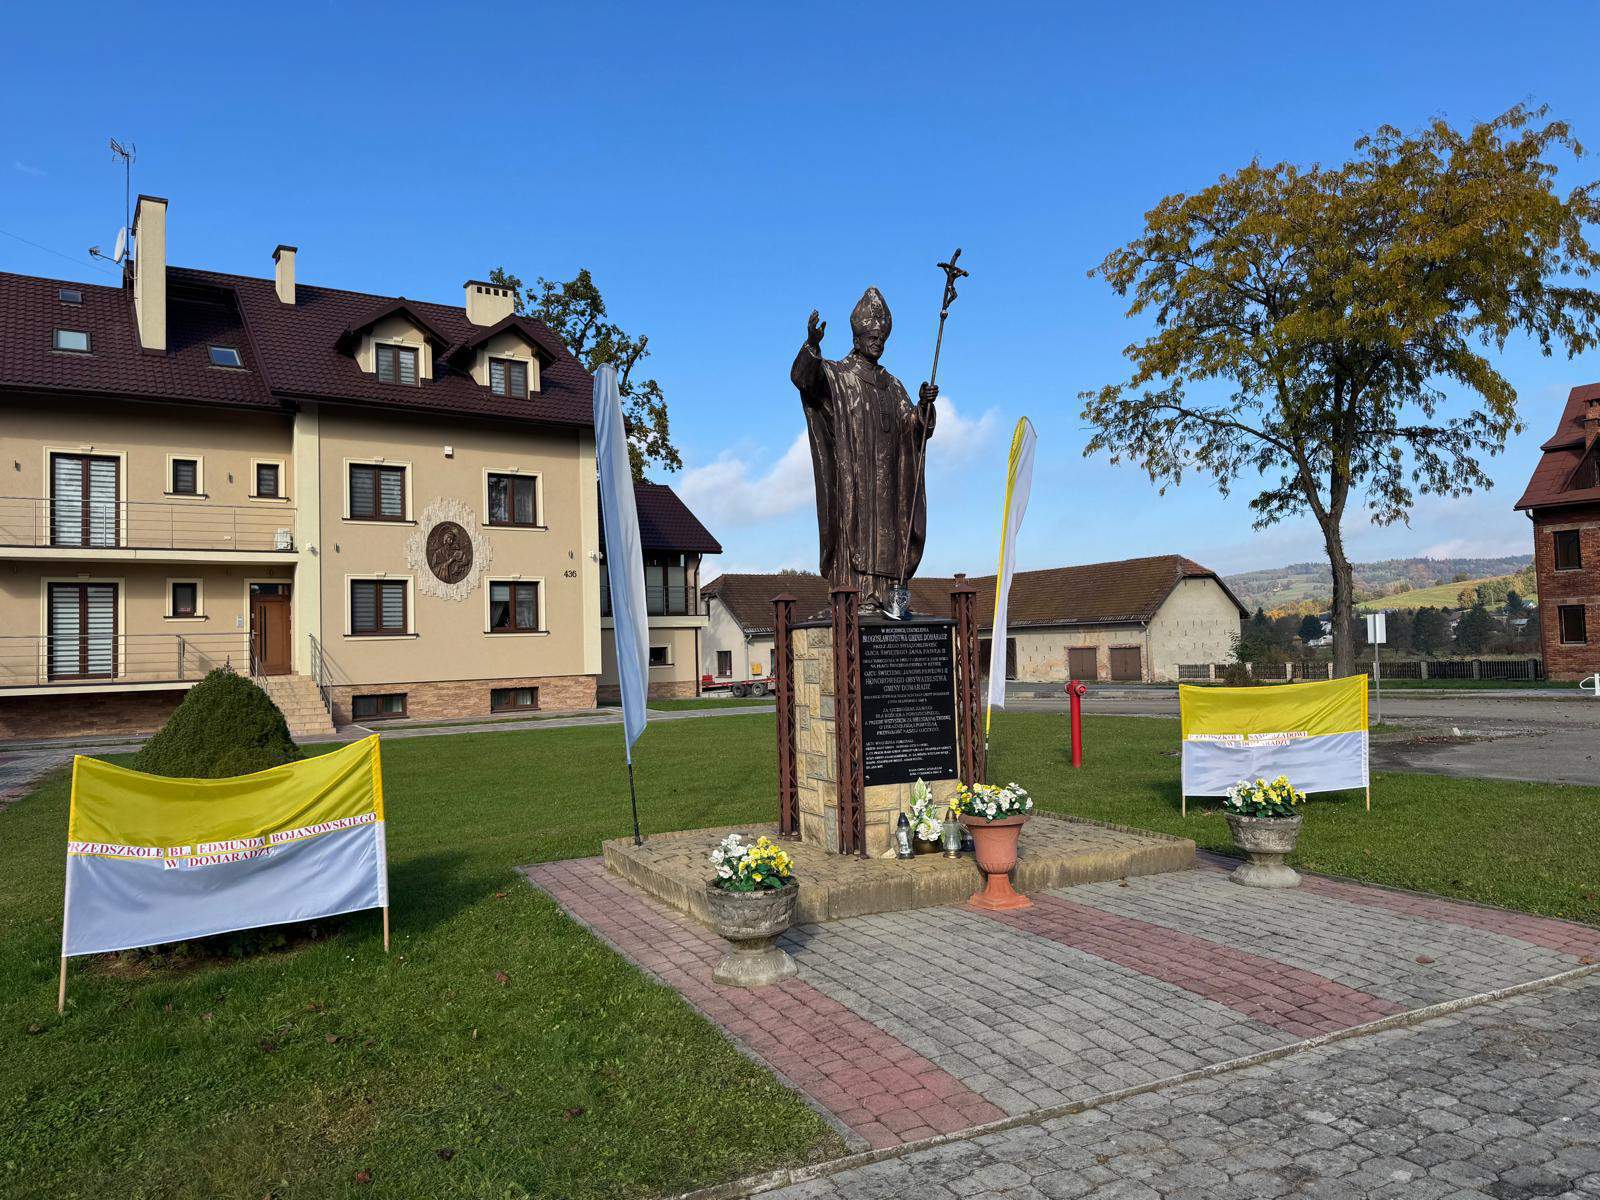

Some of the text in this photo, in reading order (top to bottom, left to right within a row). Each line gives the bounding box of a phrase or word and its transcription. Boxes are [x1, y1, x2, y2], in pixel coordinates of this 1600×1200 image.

[200, 838, 265, 854] EDMUNDA
[272, 812, 377, 843] BOJANOWSKIEGO
[166, 846, 274, 868] W DOMARADZU
